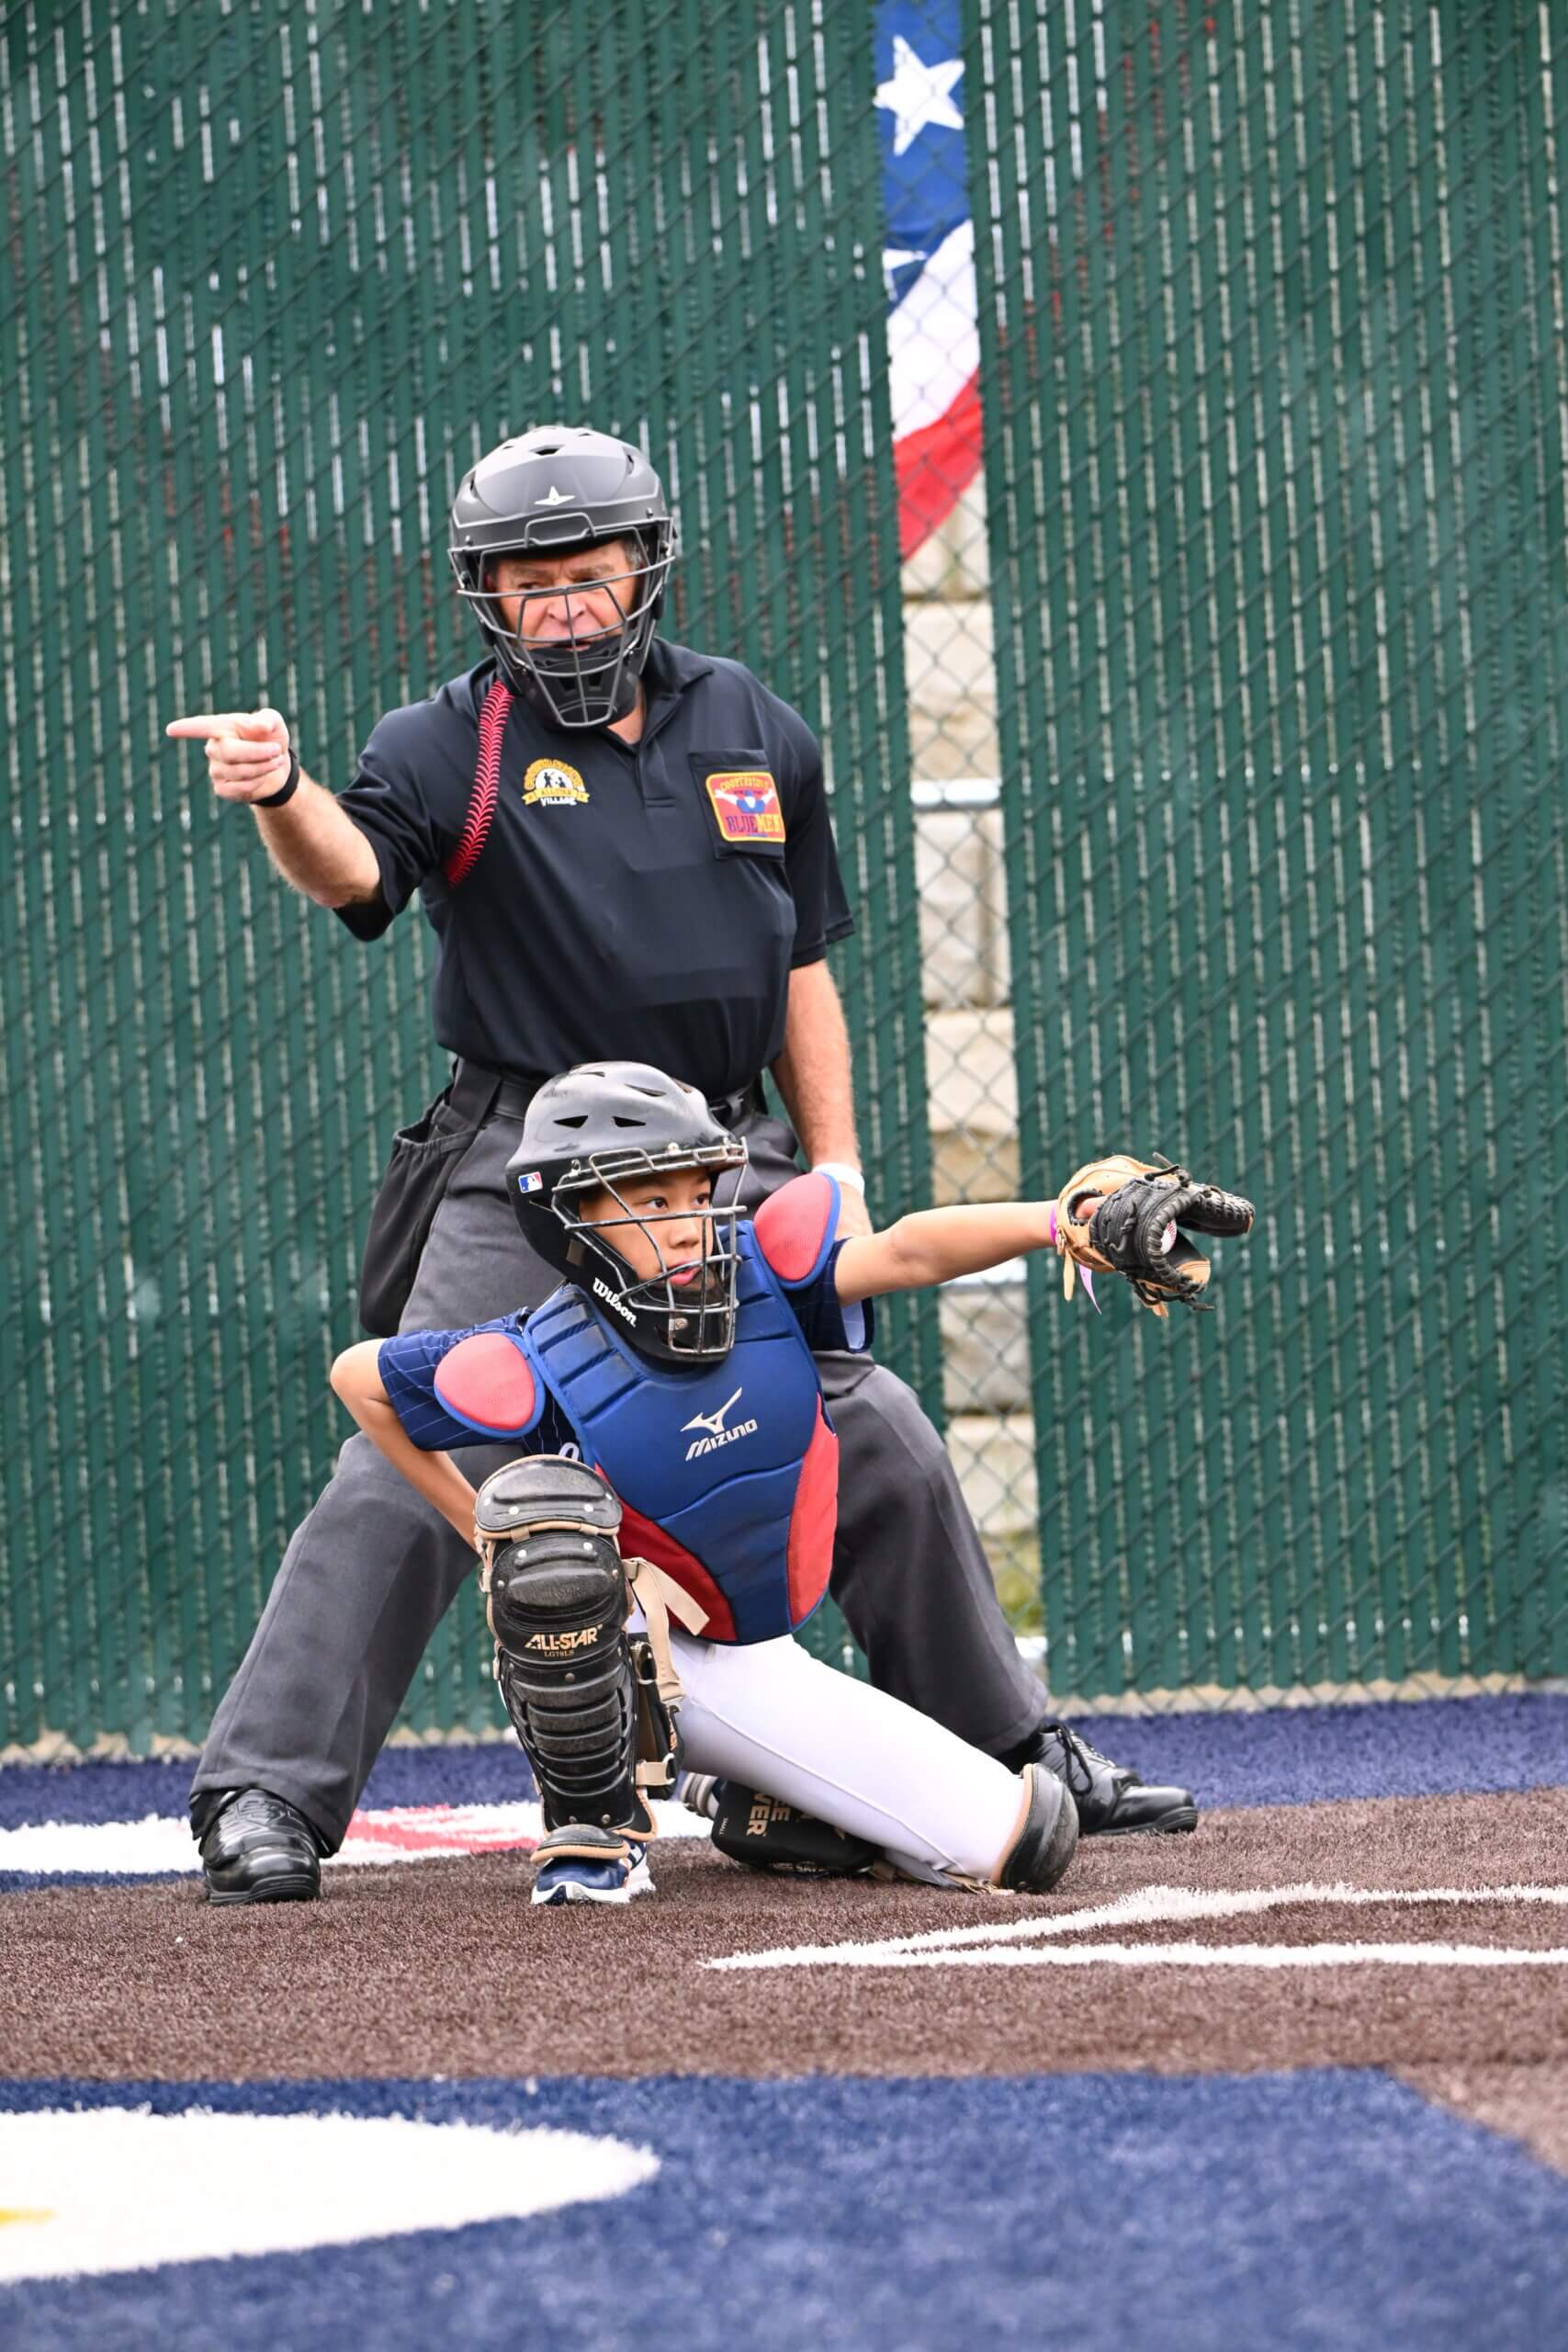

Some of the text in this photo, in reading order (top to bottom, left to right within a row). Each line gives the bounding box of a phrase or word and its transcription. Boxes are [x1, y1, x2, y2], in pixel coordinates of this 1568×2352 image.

[592, 1277, 637, 1329] Wilson
[525, 1626, 600, 1650] ALL-STAR
[746, 1792, 772, 1836] VER
